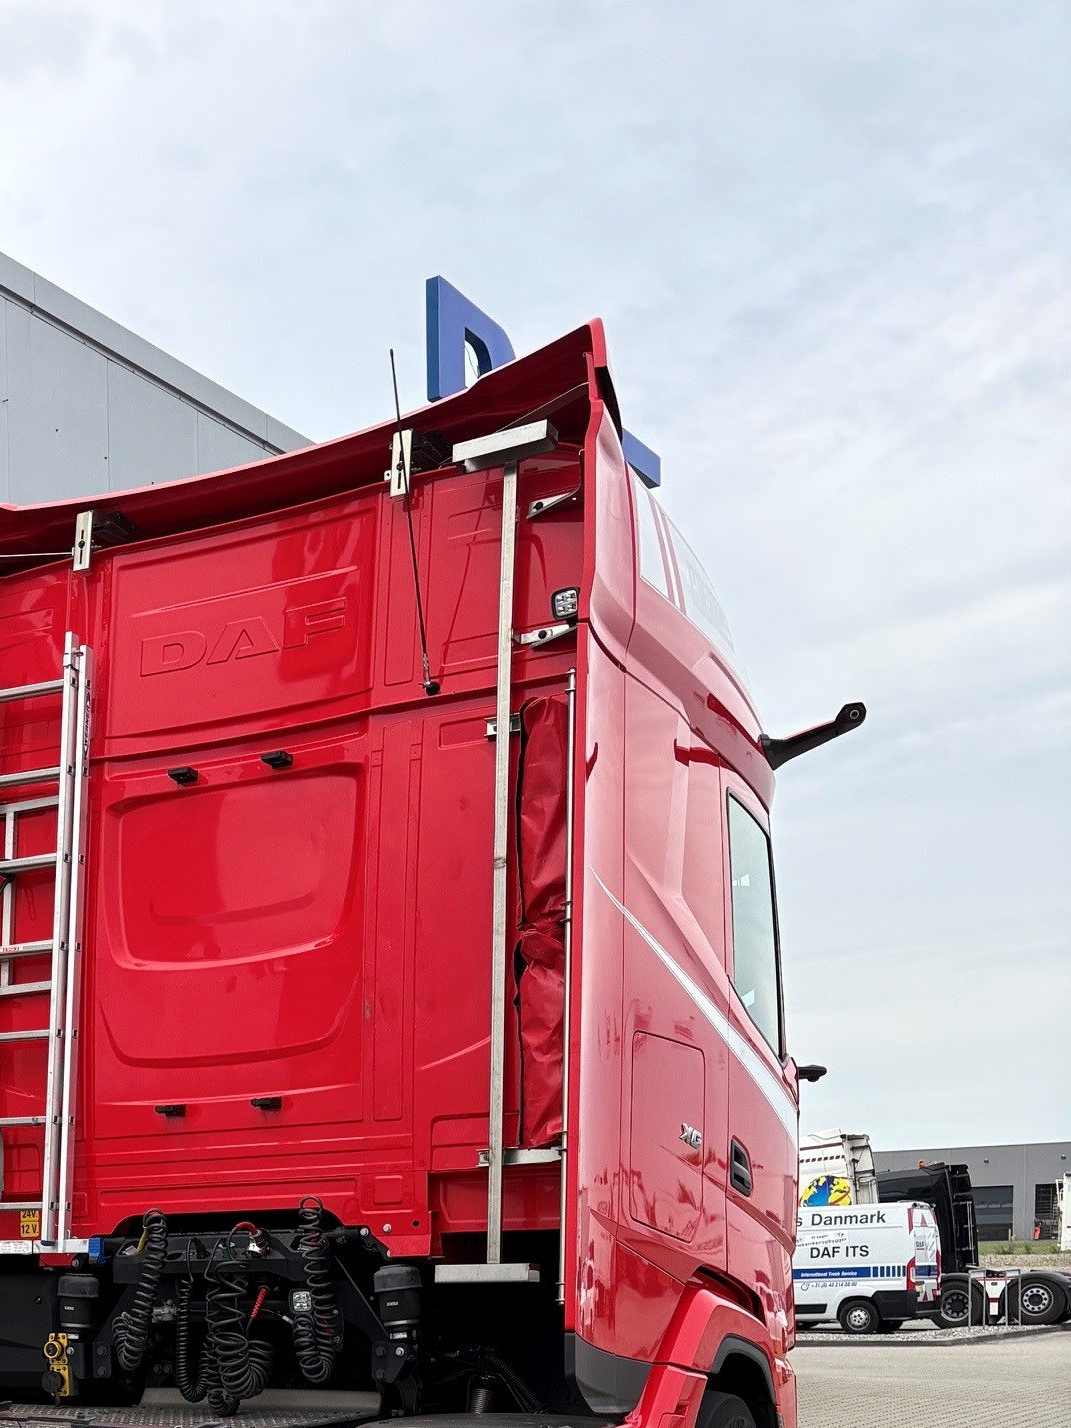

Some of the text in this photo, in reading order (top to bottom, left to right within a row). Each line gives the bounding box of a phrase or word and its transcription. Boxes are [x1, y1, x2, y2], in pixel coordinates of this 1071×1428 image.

[140, 596, 347, 677] DAF
[811, 1210, 886, 1226] Danmark
[21, 1225, 30, 1234] 12
[810, 1245, 869, 1258] DAF ITS
